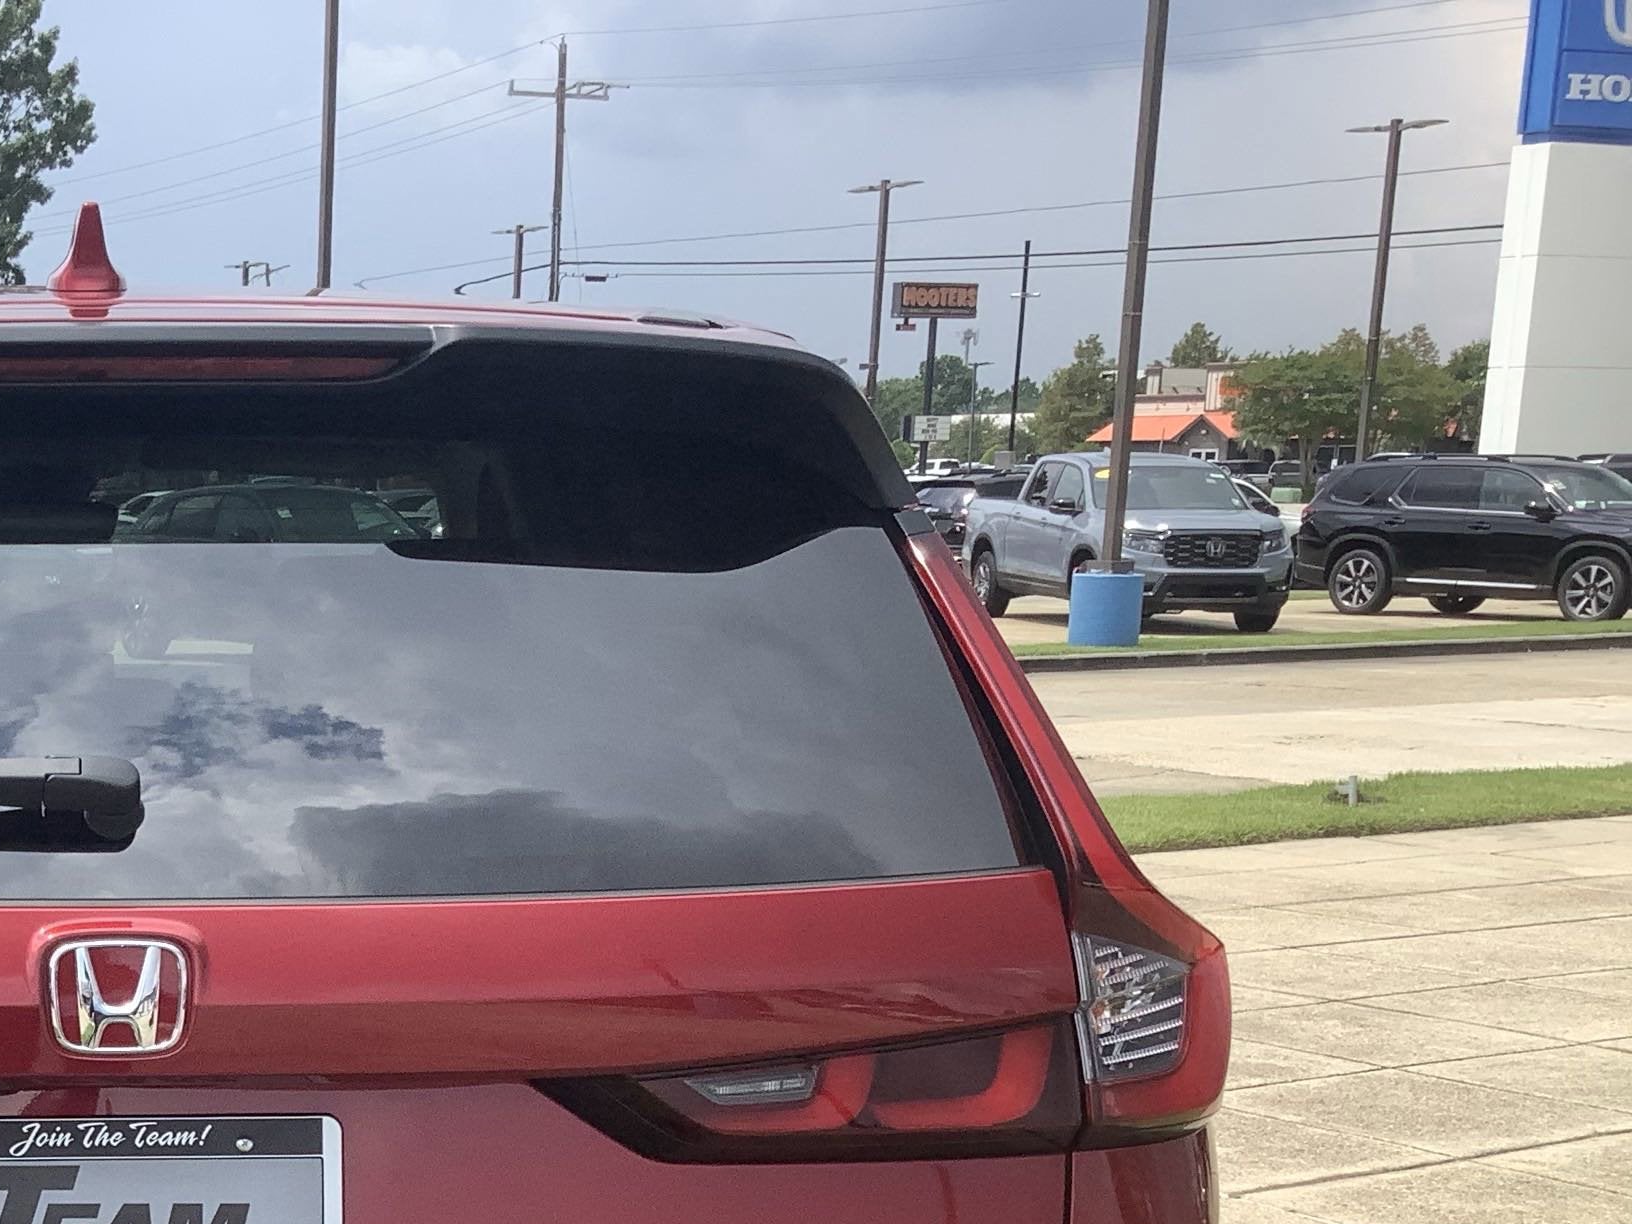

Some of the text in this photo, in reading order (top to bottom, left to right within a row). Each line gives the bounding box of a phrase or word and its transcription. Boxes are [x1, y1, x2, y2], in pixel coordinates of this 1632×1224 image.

[1564, 73, 1632, 103] HO
[902, 286, 977, 307] HOOTERS
[9, 1122, 211, 1156] Join The Team!
